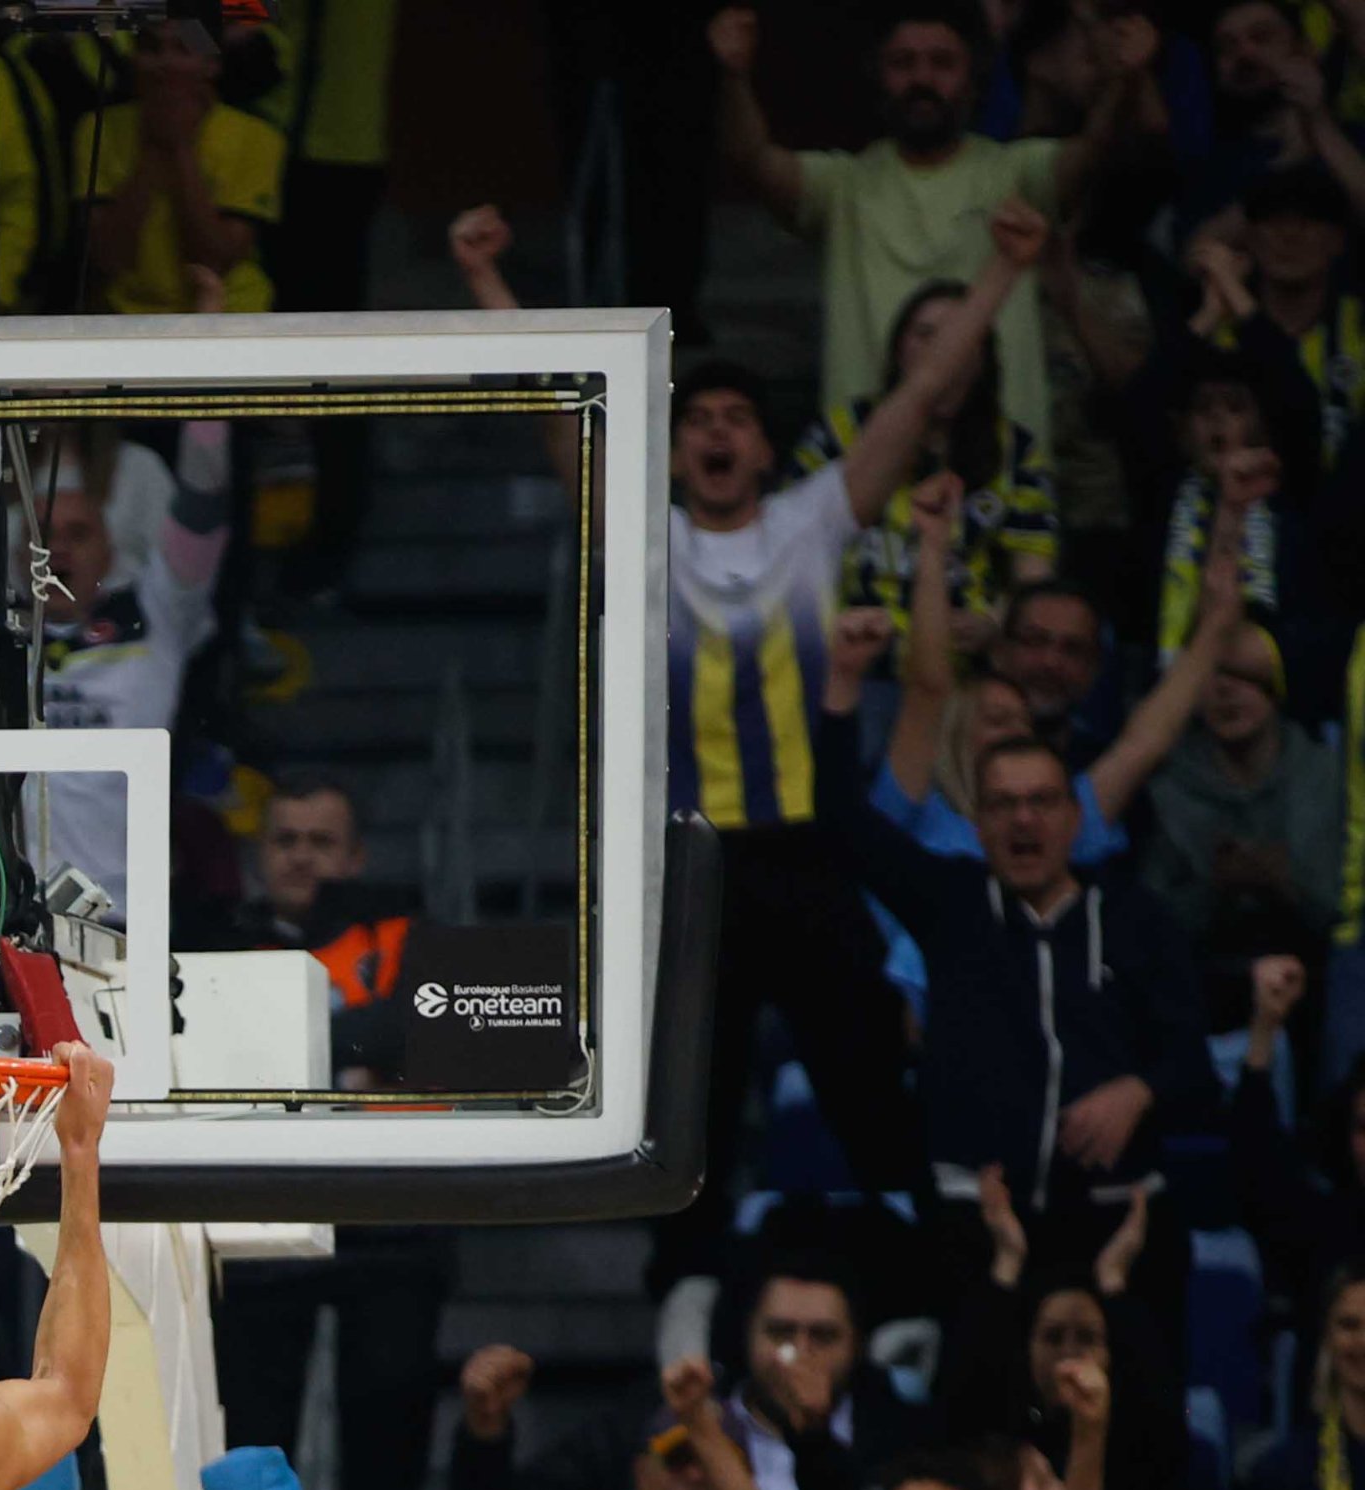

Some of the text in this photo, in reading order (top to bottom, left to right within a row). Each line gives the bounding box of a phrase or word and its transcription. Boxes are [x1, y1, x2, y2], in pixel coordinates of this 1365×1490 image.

[453, 984, 562, 996] Euroleague Basketball
[454, 994, 562, 1015] oneteam
[487, 1018, 562, 1027] TURKISH AIRLINES
